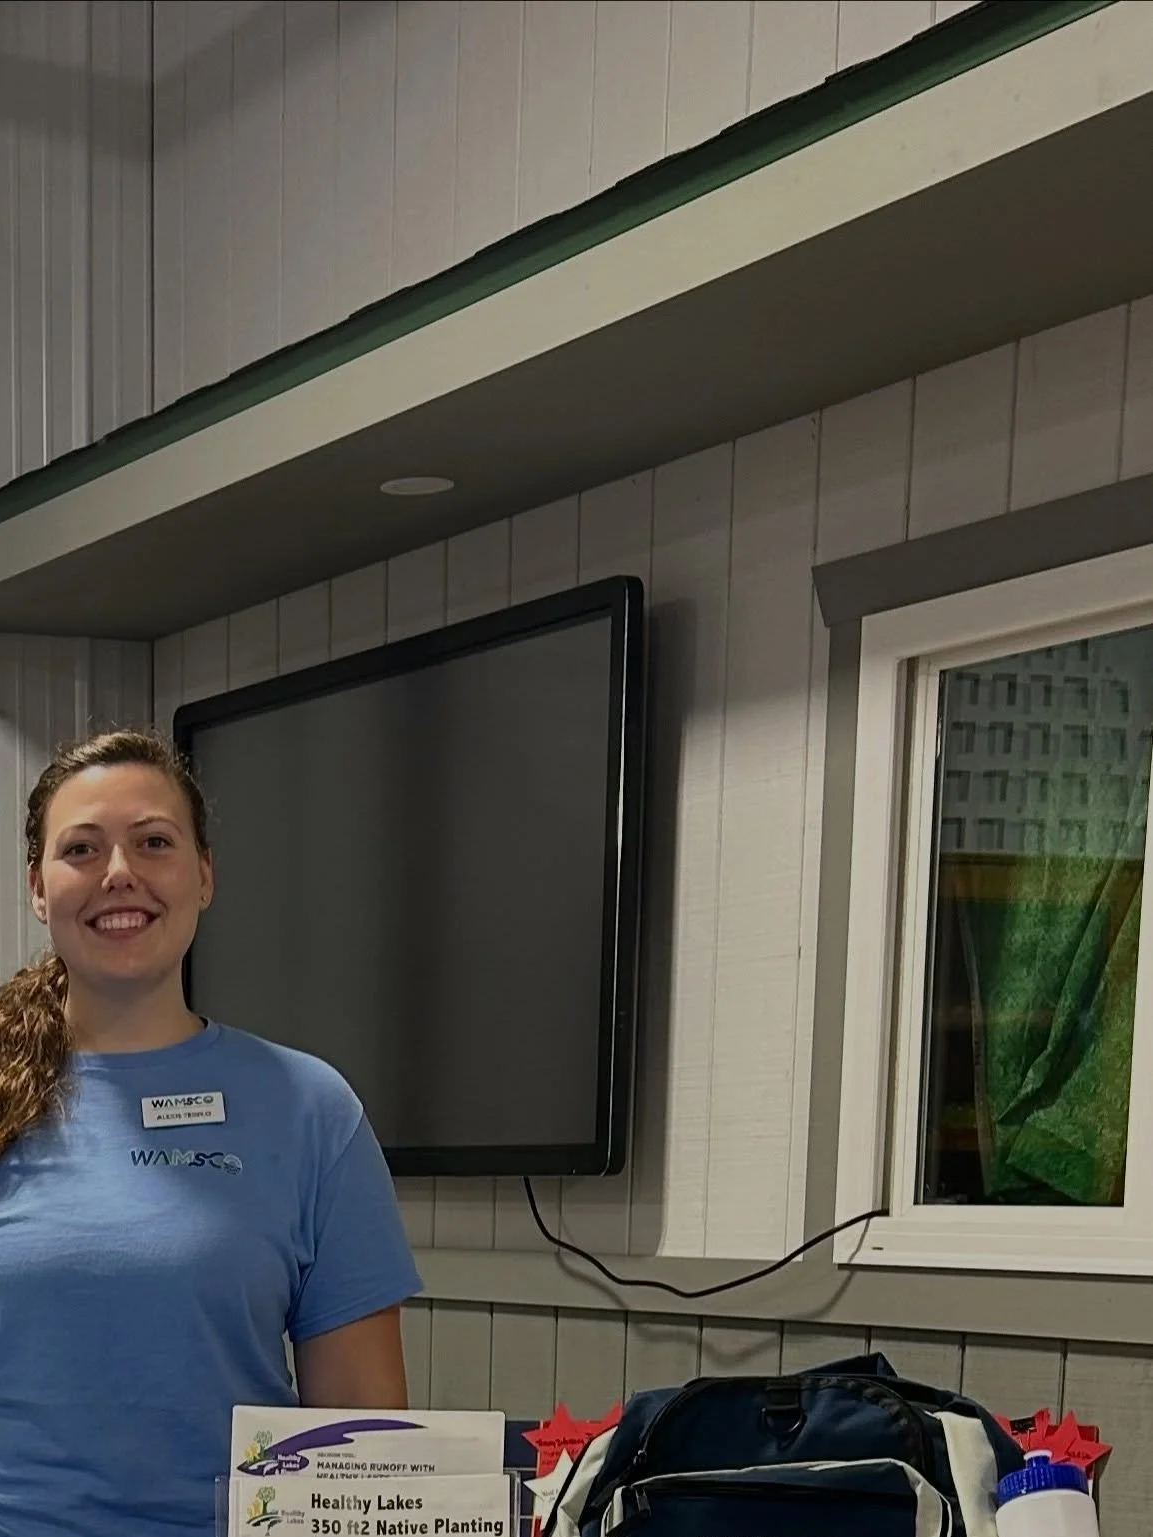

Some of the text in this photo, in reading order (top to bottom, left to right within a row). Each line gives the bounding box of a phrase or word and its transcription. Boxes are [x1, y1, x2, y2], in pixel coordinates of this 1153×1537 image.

[151, 1095, 214, 1108] WAMSCO
[130, 1149, 243, 1176] WAMSCO
[317, 1461, 435, 1473] MANAGING RUNOFF WITH
[311, 1493, 423, 1514] Healthy Lakes
[311, 1517, 503, 1537] 350 ft2 Native Planting
